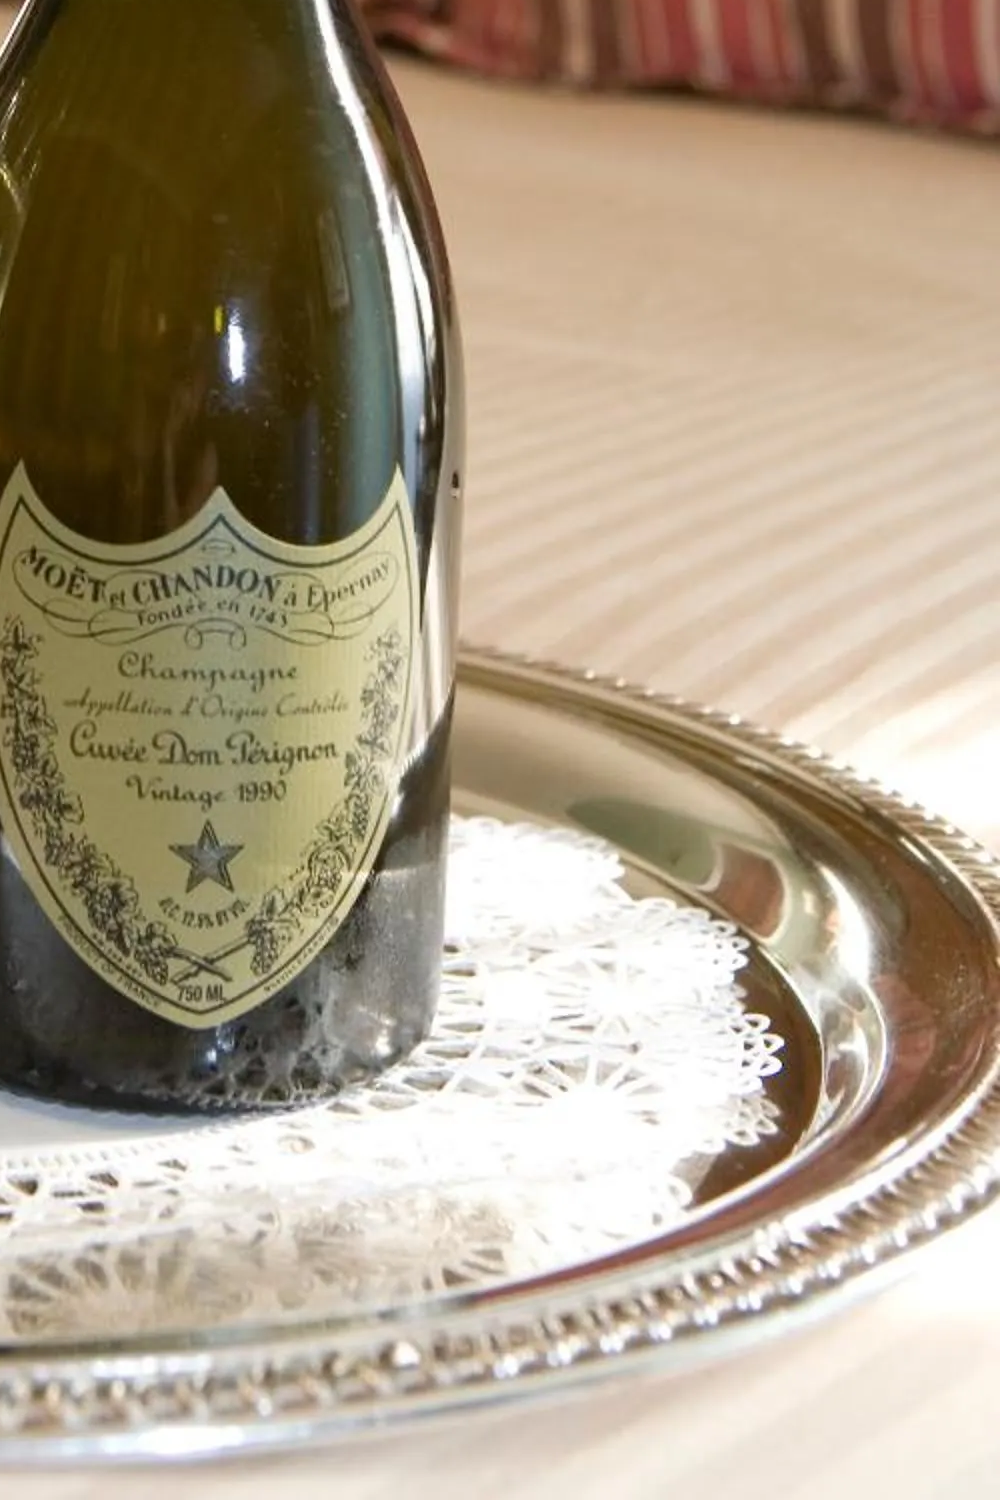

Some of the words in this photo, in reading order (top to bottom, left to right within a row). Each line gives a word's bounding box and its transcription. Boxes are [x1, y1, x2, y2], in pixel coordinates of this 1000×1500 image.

[21, 545, 107, 602] MOËT
[132, 564, 281, 605] CHANDON
[217, 598, 239, 613] en
[118, 651, 297, 692] Champagne
[63, 687, 172, 717] Appellation
[70, 719, 148, 763] Cuvée
[152, 729, 223, 765] Dom
[225, 730, 338, 776] Pérignon
[125, 774, 223, 811] Vintage
[238, 779, 287, 802] 1990
[177, 984, 203, 1002] 750
[205, 984, 226, 1002] ML
